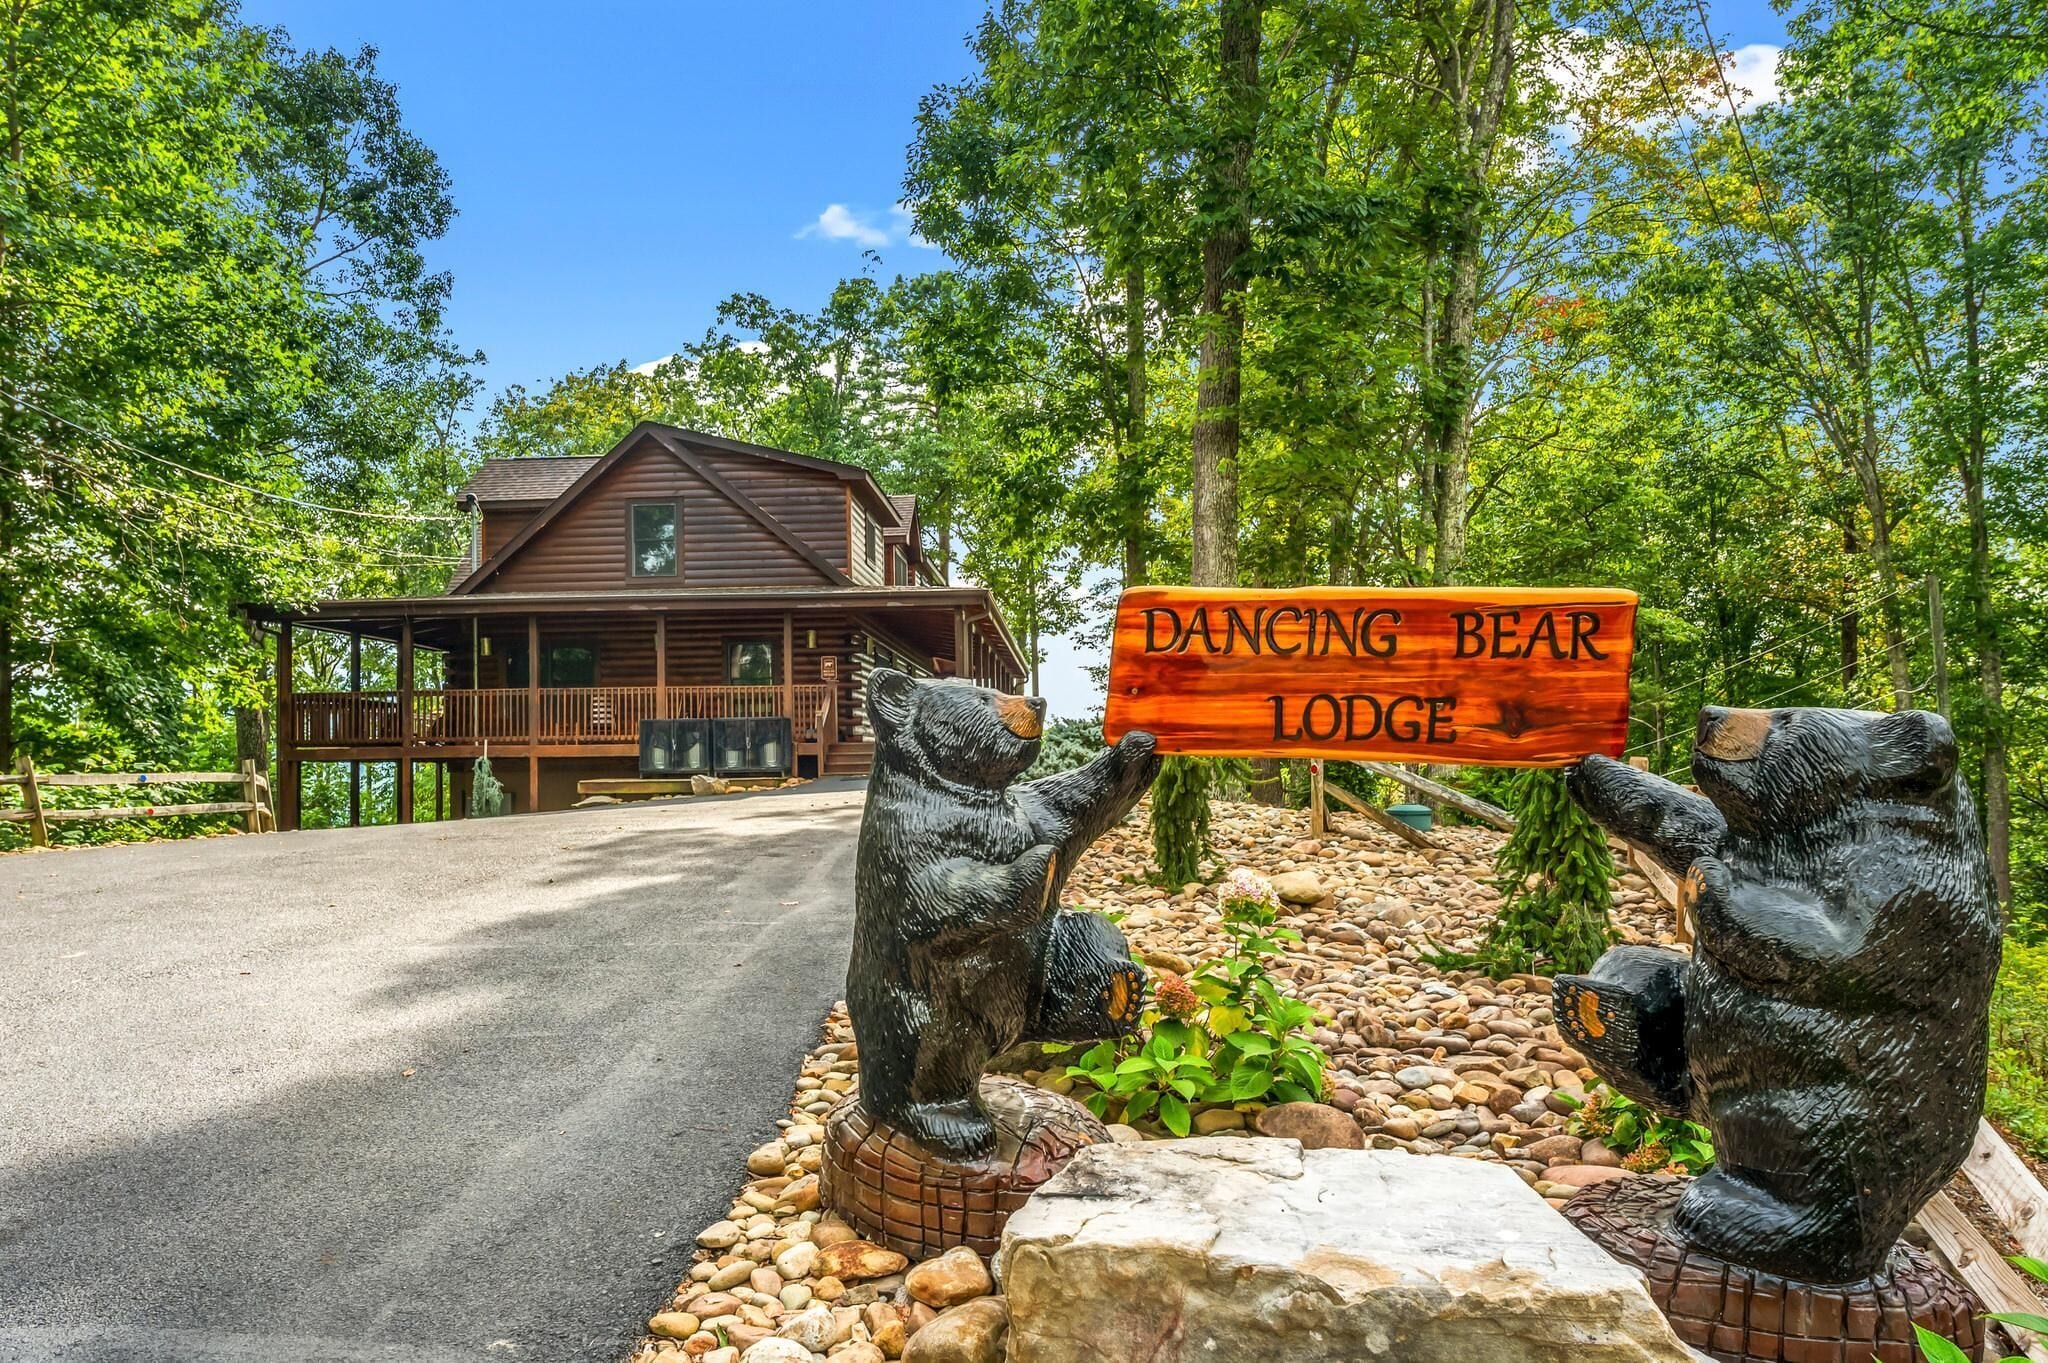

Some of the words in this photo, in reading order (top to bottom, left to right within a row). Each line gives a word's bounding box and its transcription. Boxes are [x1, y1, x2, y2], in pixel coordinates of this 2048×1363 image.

[1142, 606, 1401, 658] DANCING
[1451, 610, 1609, 660] BEAR
[1269, 694, 1458, 744] LODGE
